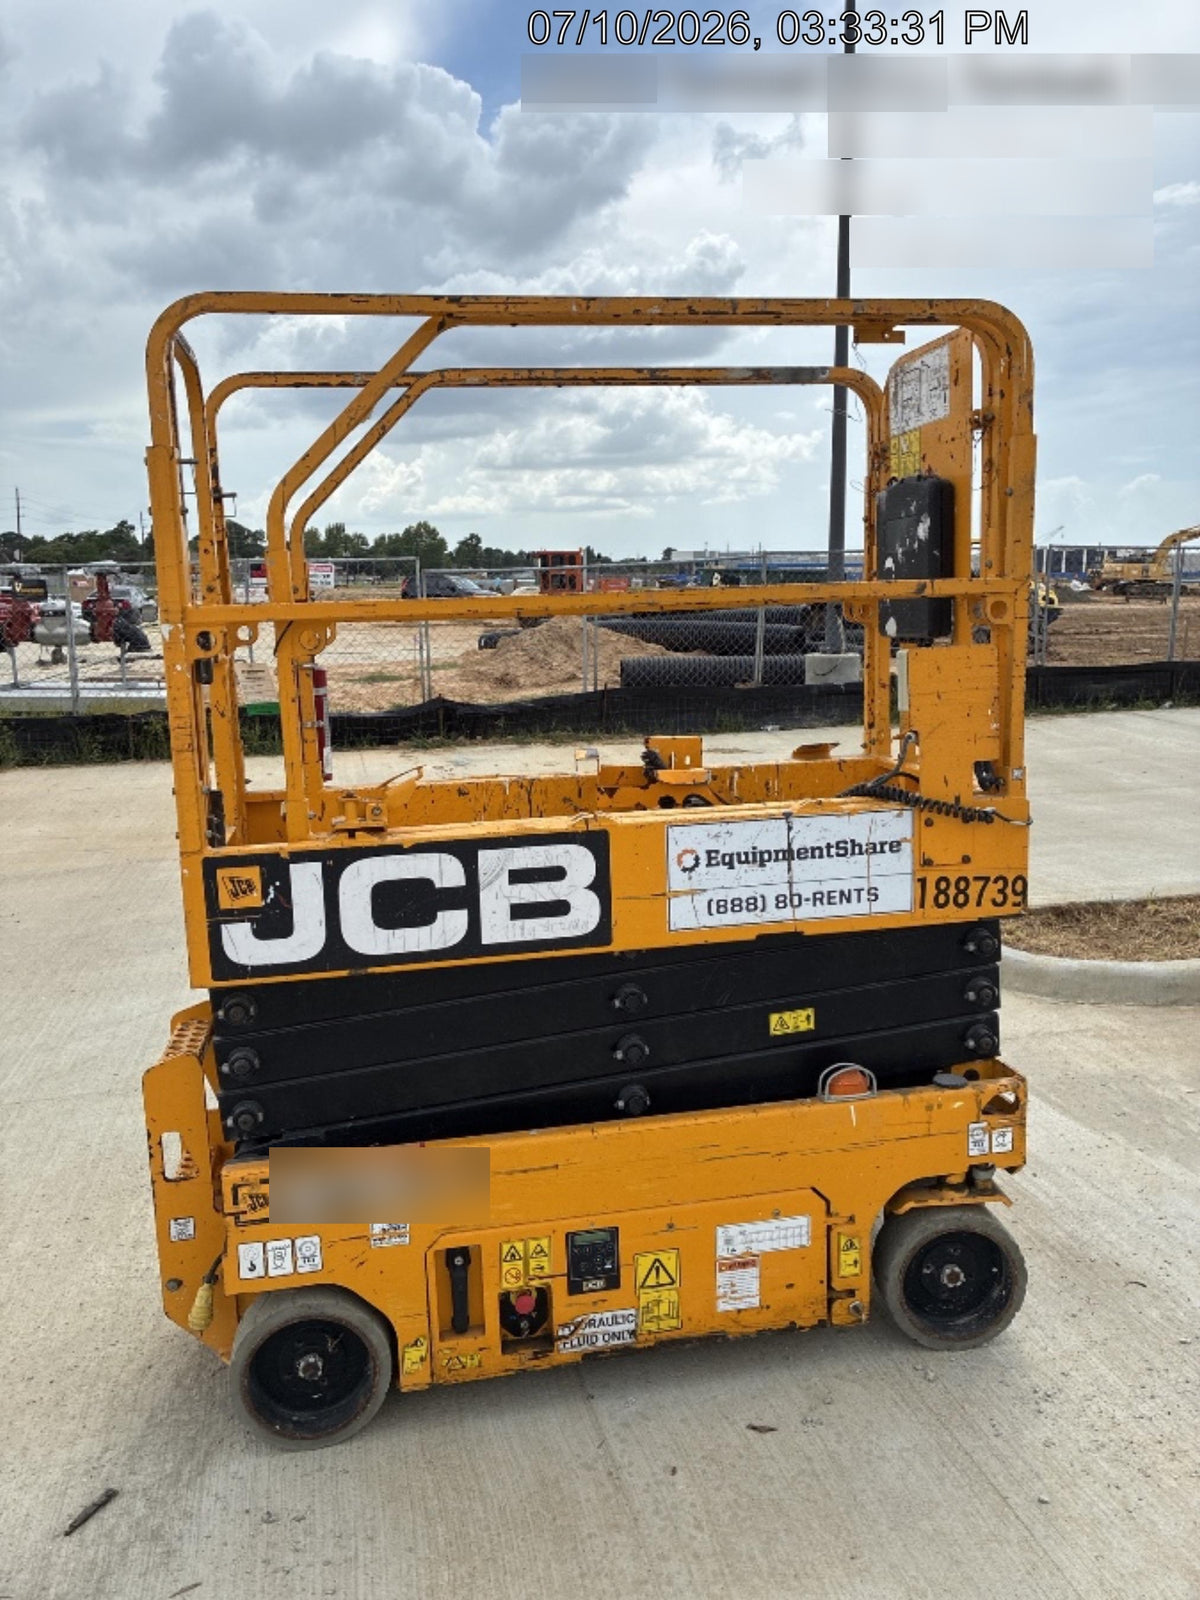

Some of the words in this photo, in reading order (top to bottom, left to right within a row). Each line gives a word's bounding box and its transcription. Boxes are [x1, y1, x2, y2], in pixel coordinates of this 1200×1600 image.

[704, 839, 902, 869] EquipmentShare
[220, 843, 601, 967] JCB
[706, 894, 767, 917] (888)
[774, 886, 880, 910] 80-RENTS
[917, 874, 1028, 910] 188739
[563, 1334, 599, 1349] FLUID
[602, 1330, 636, 1343] ONLY
